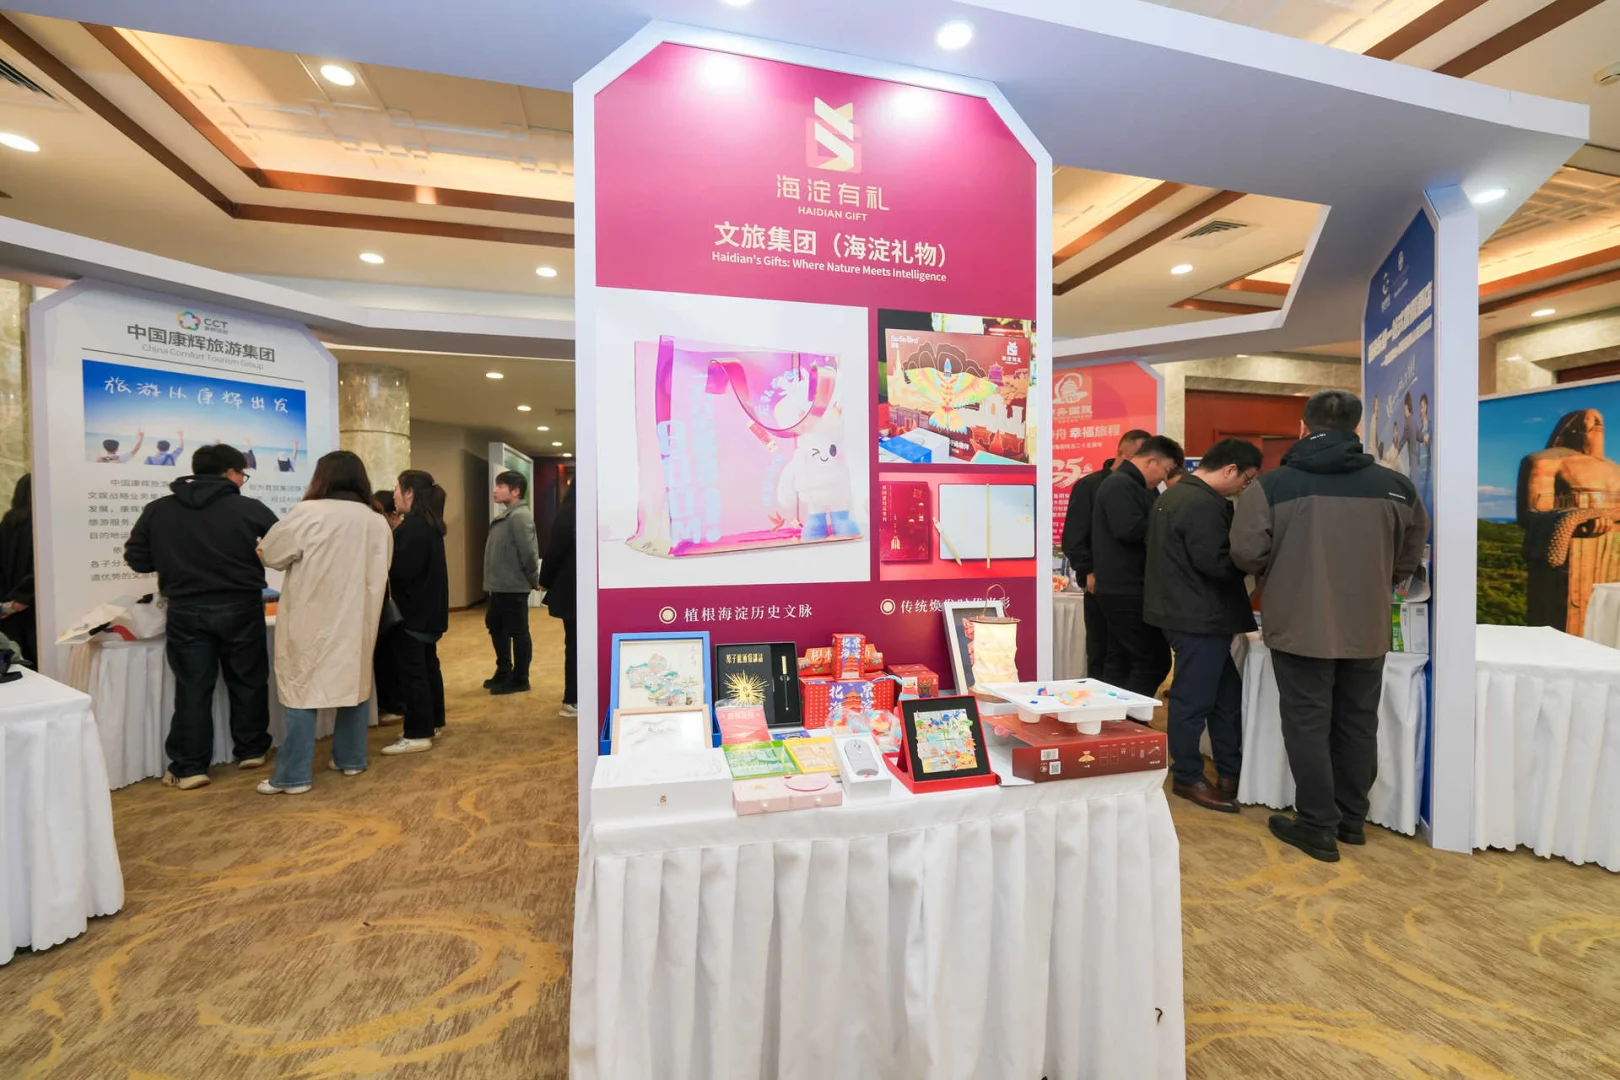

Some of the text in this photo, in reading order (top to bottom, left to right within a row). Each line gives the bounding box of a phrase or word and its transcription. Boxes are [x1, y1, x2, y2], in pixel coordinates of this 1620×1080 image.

[776, 175, 889, 211] 海淀有礼
[798, 206, 867, 221] HAIDIAN GIFT
[712, 251, 946, 282] Haidian's Gifts: Where Nature Meets Intelligence
[204, 318, 228, 328] CCT
[127, 324, 275, 362] 中国康辉旅游集团
[142, 344, 264, 370] China Comfort Tourism Group
[1069, 424, 1120, 439] 幸福旅程
[684, 604, 812, 623] 植根海淀历史文脉
